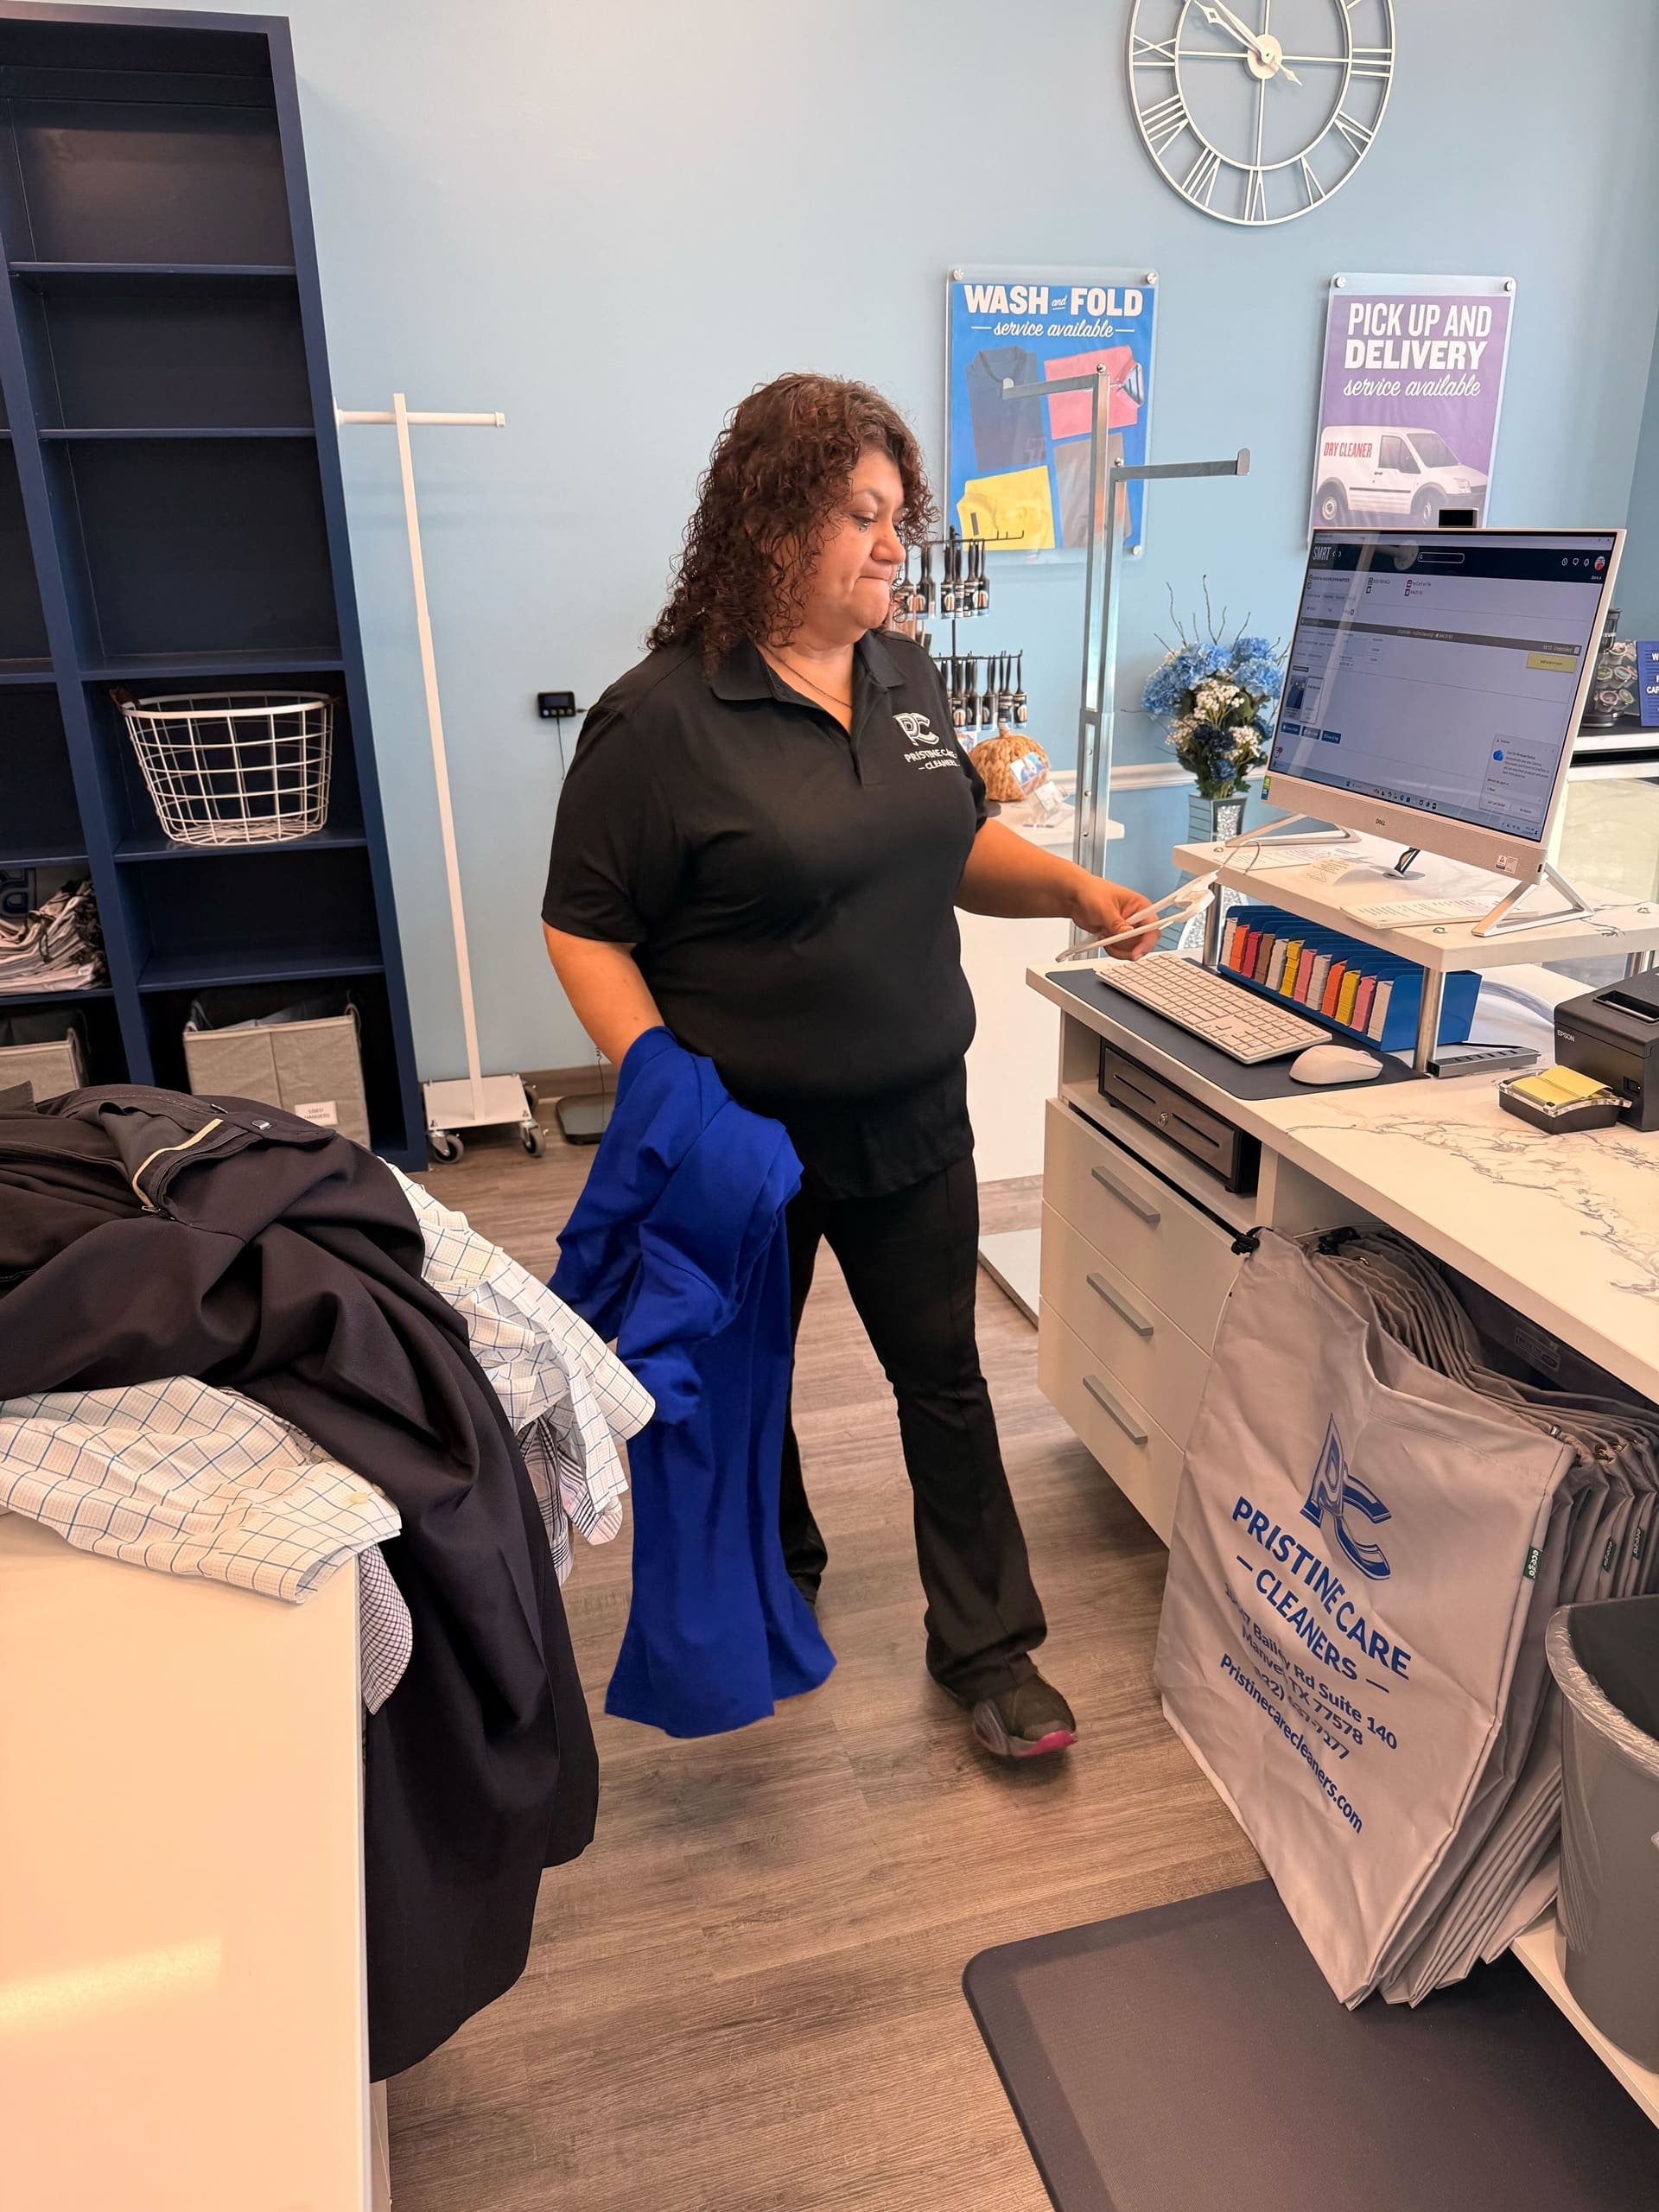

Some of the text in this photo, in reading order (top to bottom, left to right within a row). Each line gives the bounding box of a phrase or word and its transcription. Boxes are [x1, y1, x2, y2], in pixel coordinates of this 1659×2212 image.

[963, 284, 1143, 316] WASH and FOLD
[993, 319, 1114, 338] service available
[1347, 302, 1492, 337] PICK UP AND
[1344, 339, 1488, 370] DELIVERY
[1343, 373, 1481, 397] service available
[1323, 442, 1373, 458] DRY CLEANER
[1312, 546, 1332, 561] SMRT
[1557, 1029, 1575, 1042] EPSON
[1255, 1568, 1358, 1681] CLEANERS
[1294, 1664, 1315, 1690] Rd
[1319, 1682, 1363, 1723] Suite
[1366, 1716, 1398, 1751] 140
[1313, 1698, 1363, 1745] 77578
[1220, 1653, 1363, 1834] Pristinecarecleaners.com
